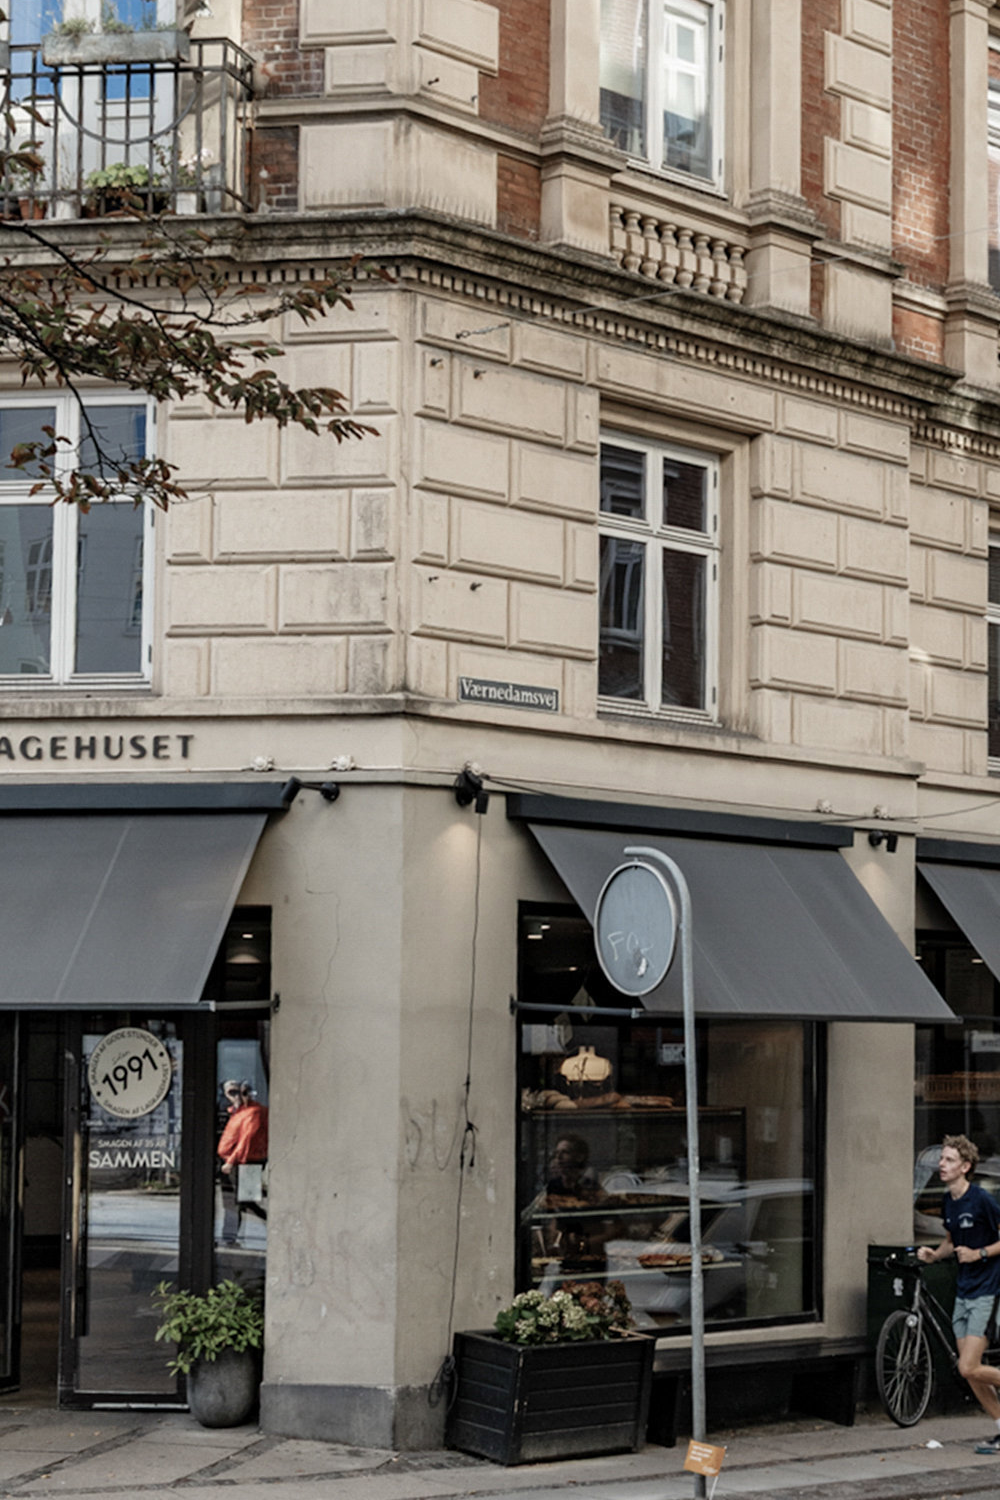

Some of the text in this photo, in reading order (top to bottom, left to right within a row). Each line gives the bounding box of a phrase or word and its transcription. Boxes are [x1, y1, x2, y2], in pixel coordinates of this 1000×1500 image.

[462, 678, 556, 710] Værnedamsvej
[0, 735, 194, 760] AGEHUSET
[102, 1049, 158, 1095] 1991
[98, 1139, 132, 1148] SMAGEN
[89, 1150, 175, 1168] SAMMEN
